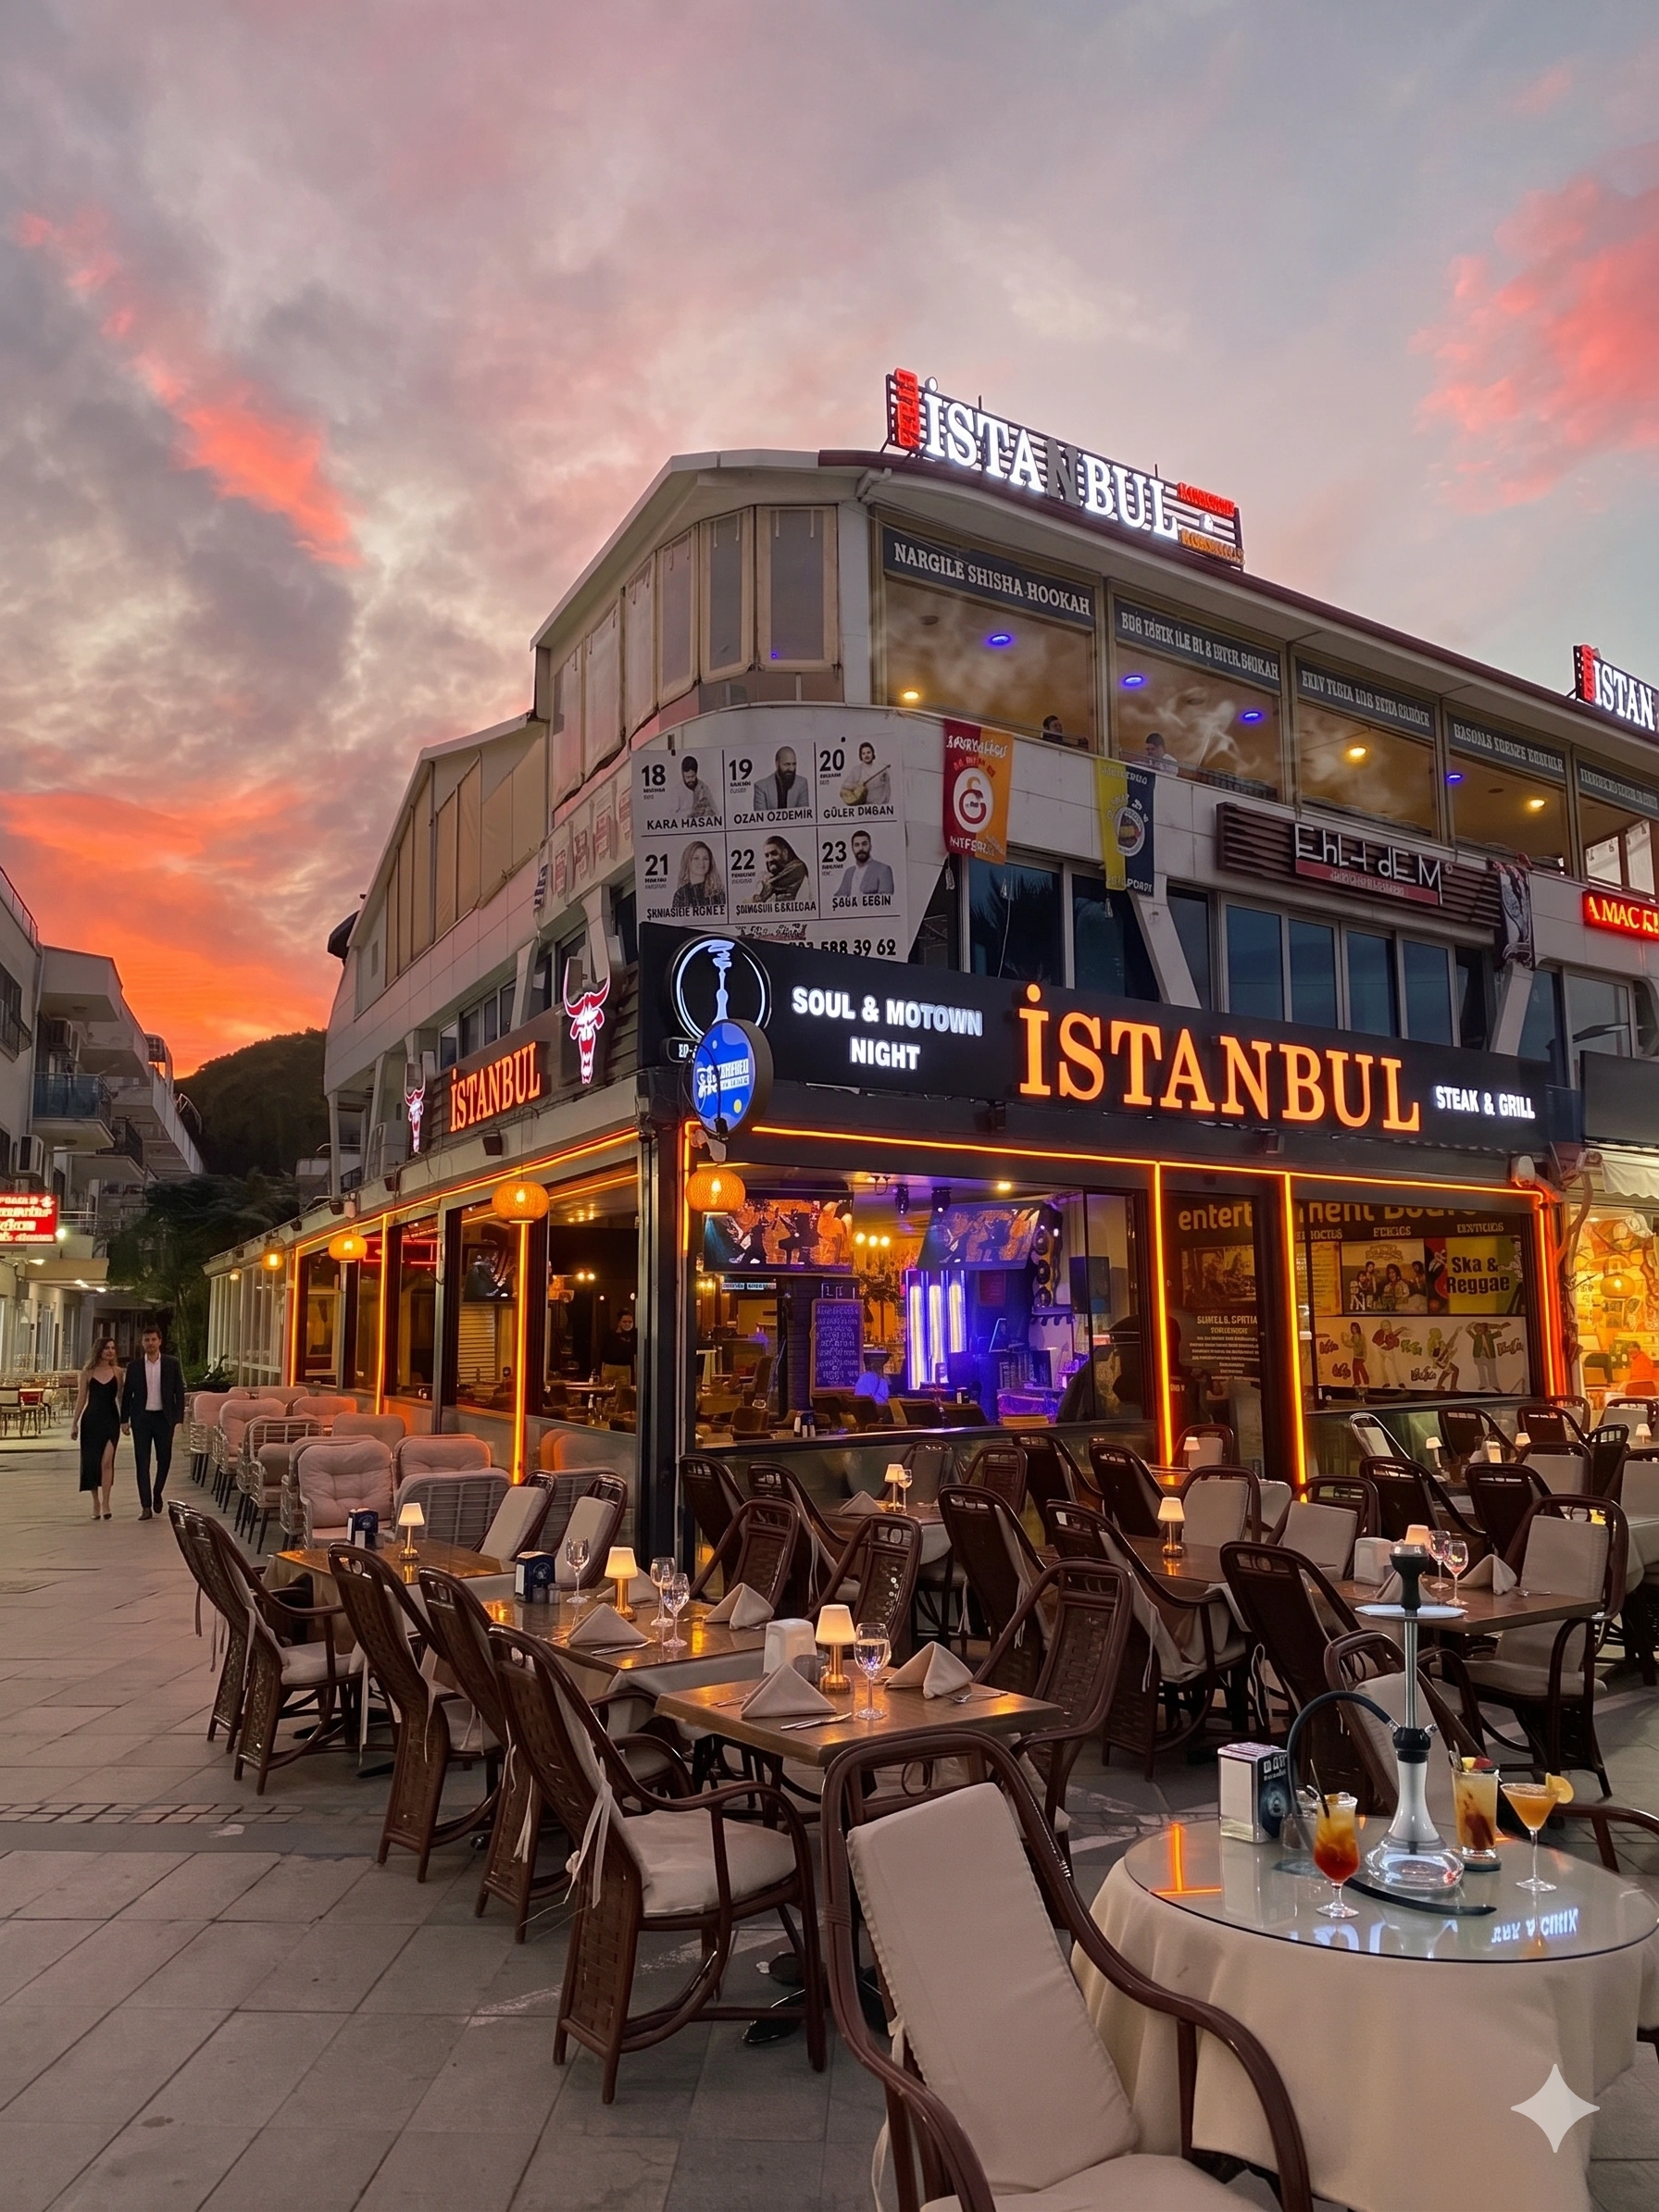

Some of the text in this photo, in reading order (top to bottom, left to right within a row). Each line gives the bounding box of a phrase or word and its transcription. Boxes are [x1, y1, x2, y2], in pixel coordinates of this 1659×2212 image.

[924, 376, 1179, 541] İSTANBUL
[893, 542, 1091, 616] NARGILE SHISHA HOOKAH
[728, 758, 754, 781] 19
[819, 749, 845, 773] 20
[641, 764, 667, 787] 18
[646, 815, 723, 831] KARA HASAN
[733, 811, 765, 825] OZAN
[823, 806, 855, 820] GÜLER
[730, 849, 755, 871] 22
[821, 840, 847, 863] 23
[644, 853, 668, 876] 21
[853, 939, 872, 957] 39
[876, 938, 897, 956] 62
[792, 986, 984, 1038] SOUL & MOTOWN
[850, 1036, 921, 1071] NIGHT
[1018, 983, 1420, 1133] İSTANBUL
[449, 1041, 541, 1133] İSTANBUL
[1435, 1085, 1537, 1120] STEAK & GRILL
[1451, 1255, 1500, 1274] Ska &
[1446, 1274, 1511, 1295] Reggae
